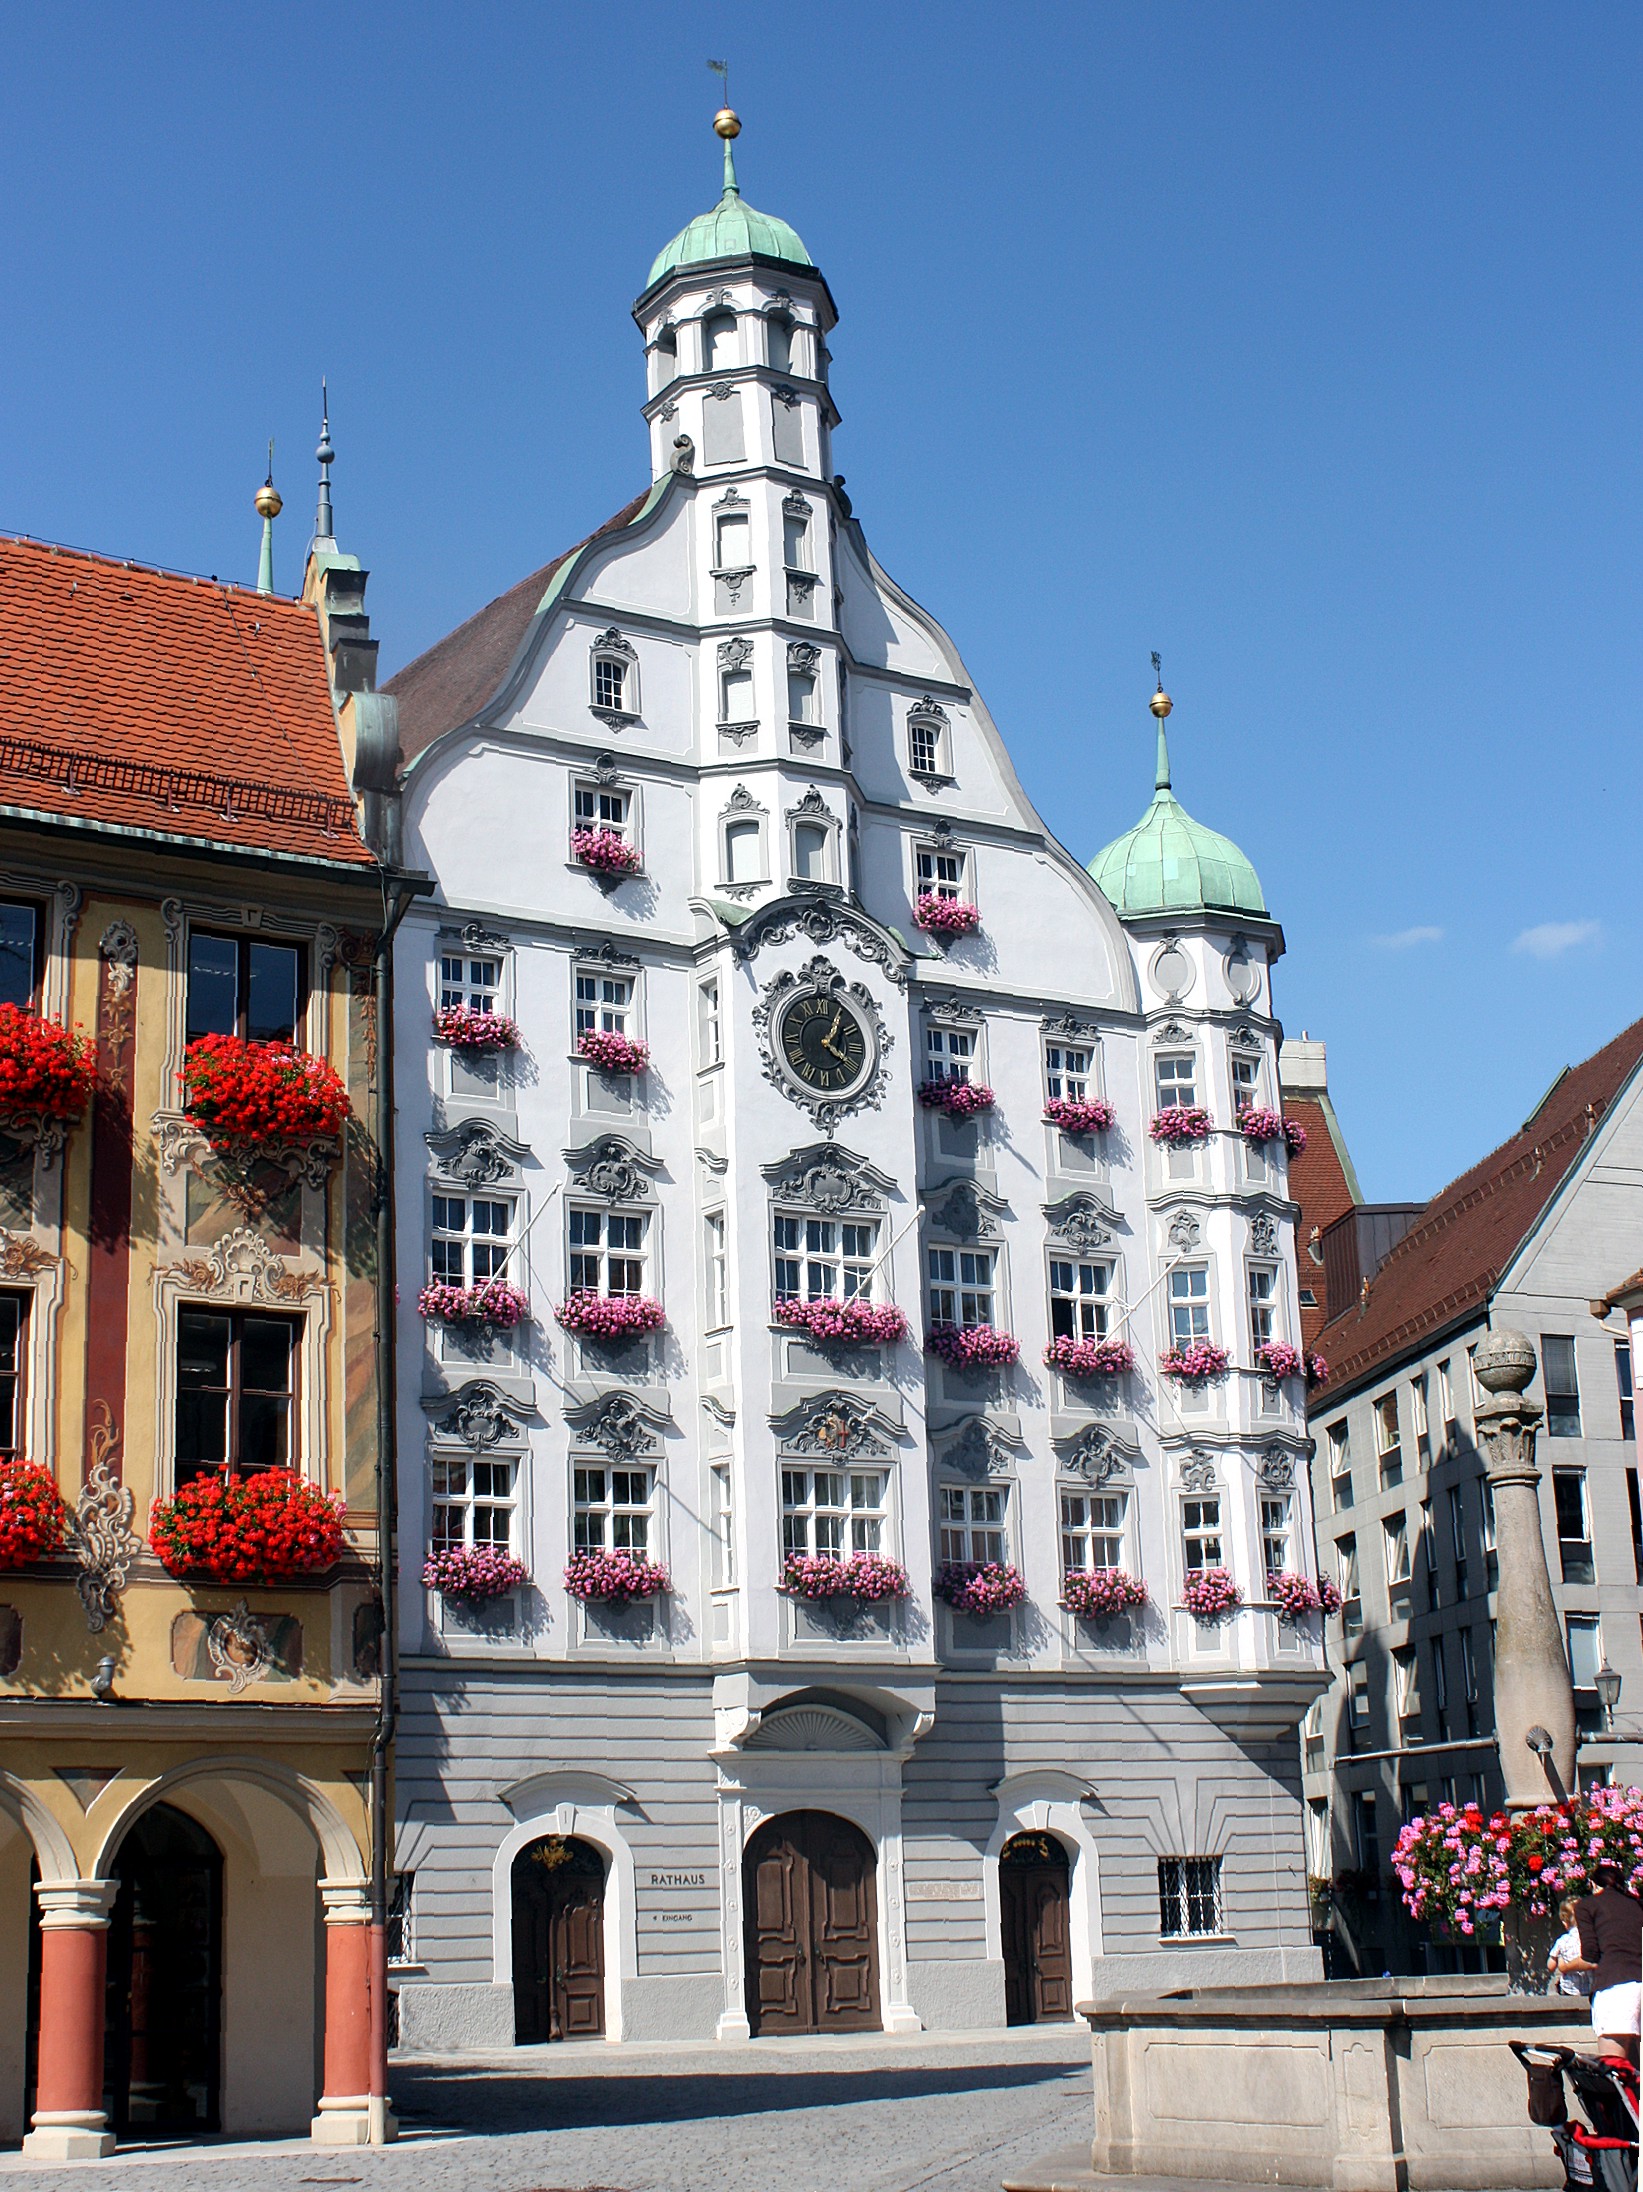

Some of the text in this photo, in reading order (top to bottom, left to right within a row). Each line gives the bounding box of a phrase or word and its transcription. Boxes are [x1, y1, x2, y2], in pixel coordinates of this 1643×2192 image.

[800, 1000, 814, 1017] XI
[816, 998, 829, 1015] XII
[788, 1012, 803, 1026] X
[843, 1023, 858, 1036] II
[785, 1032, 799, 1044] IX
[849, 1042, 863, 1053] III
[788, 1048, 806, 1066] VIII
[801, 1062, 816, 1081] VII
[820, 1070, 830, 1087] VI
[836, 1067, 847, 1084] V
[651, 1874, 706, 1886] RATHAUS
[662, 1914, 693, 1922] EINGANG
